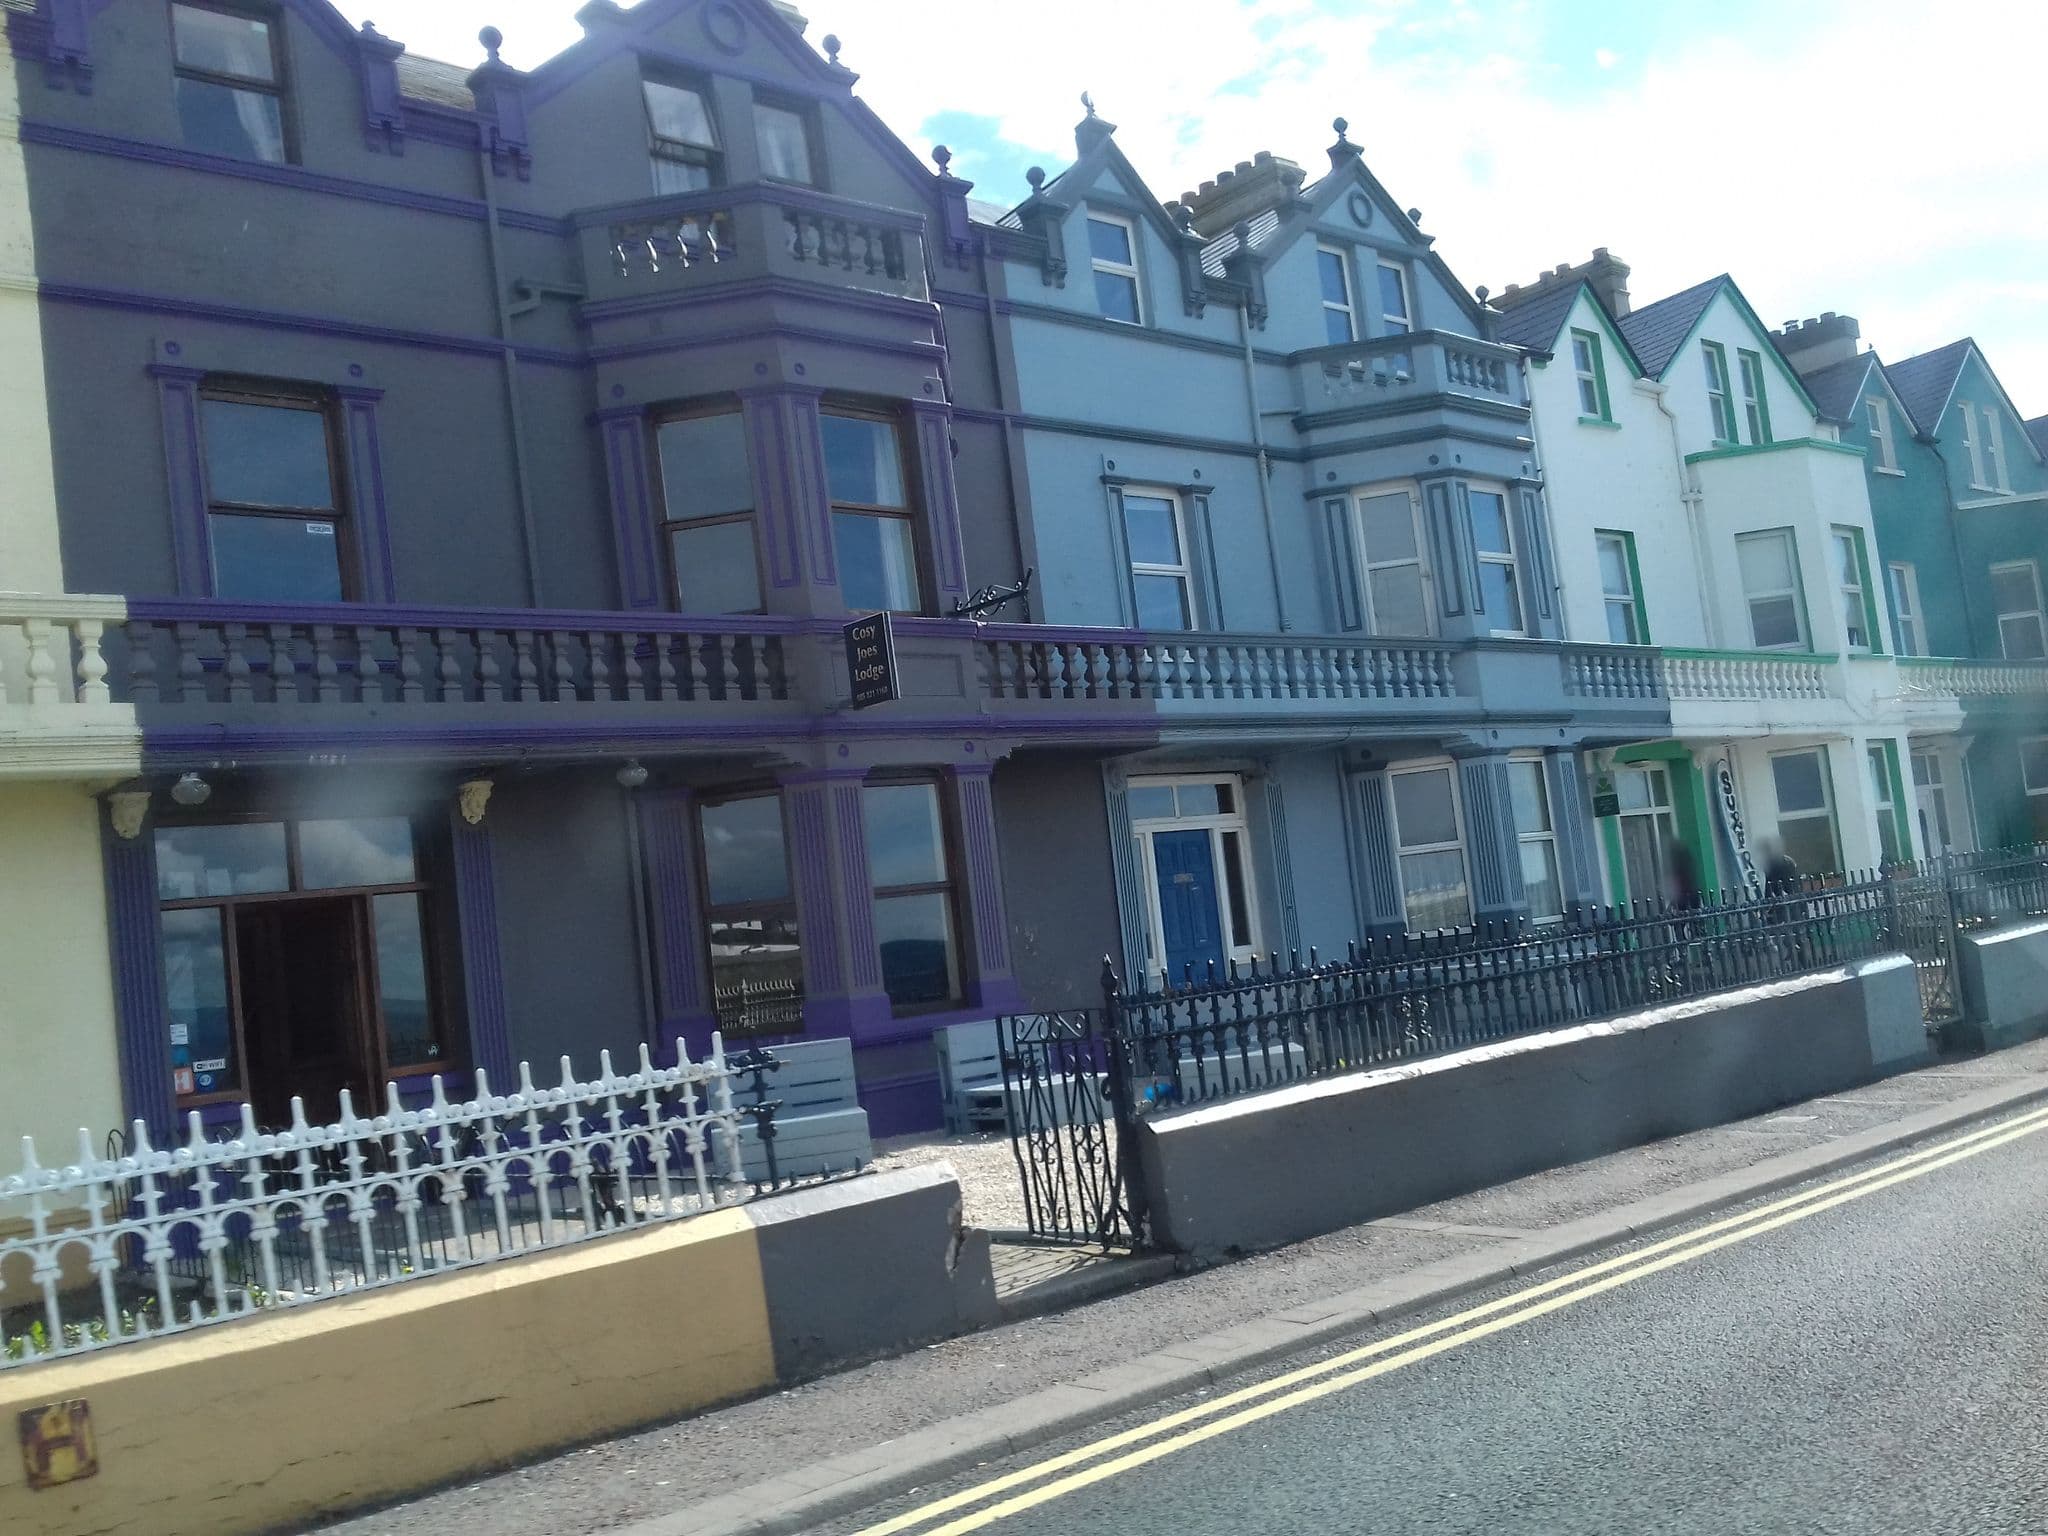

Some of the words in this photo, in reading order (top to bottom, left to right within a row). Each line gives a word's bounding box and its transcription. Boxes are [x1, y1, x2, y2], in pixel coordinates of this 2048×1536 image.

[852, 625, 875, 640] Cosy
[857, 645, 878, 662] Joes
[855, 664, 884, 681] Lodge
